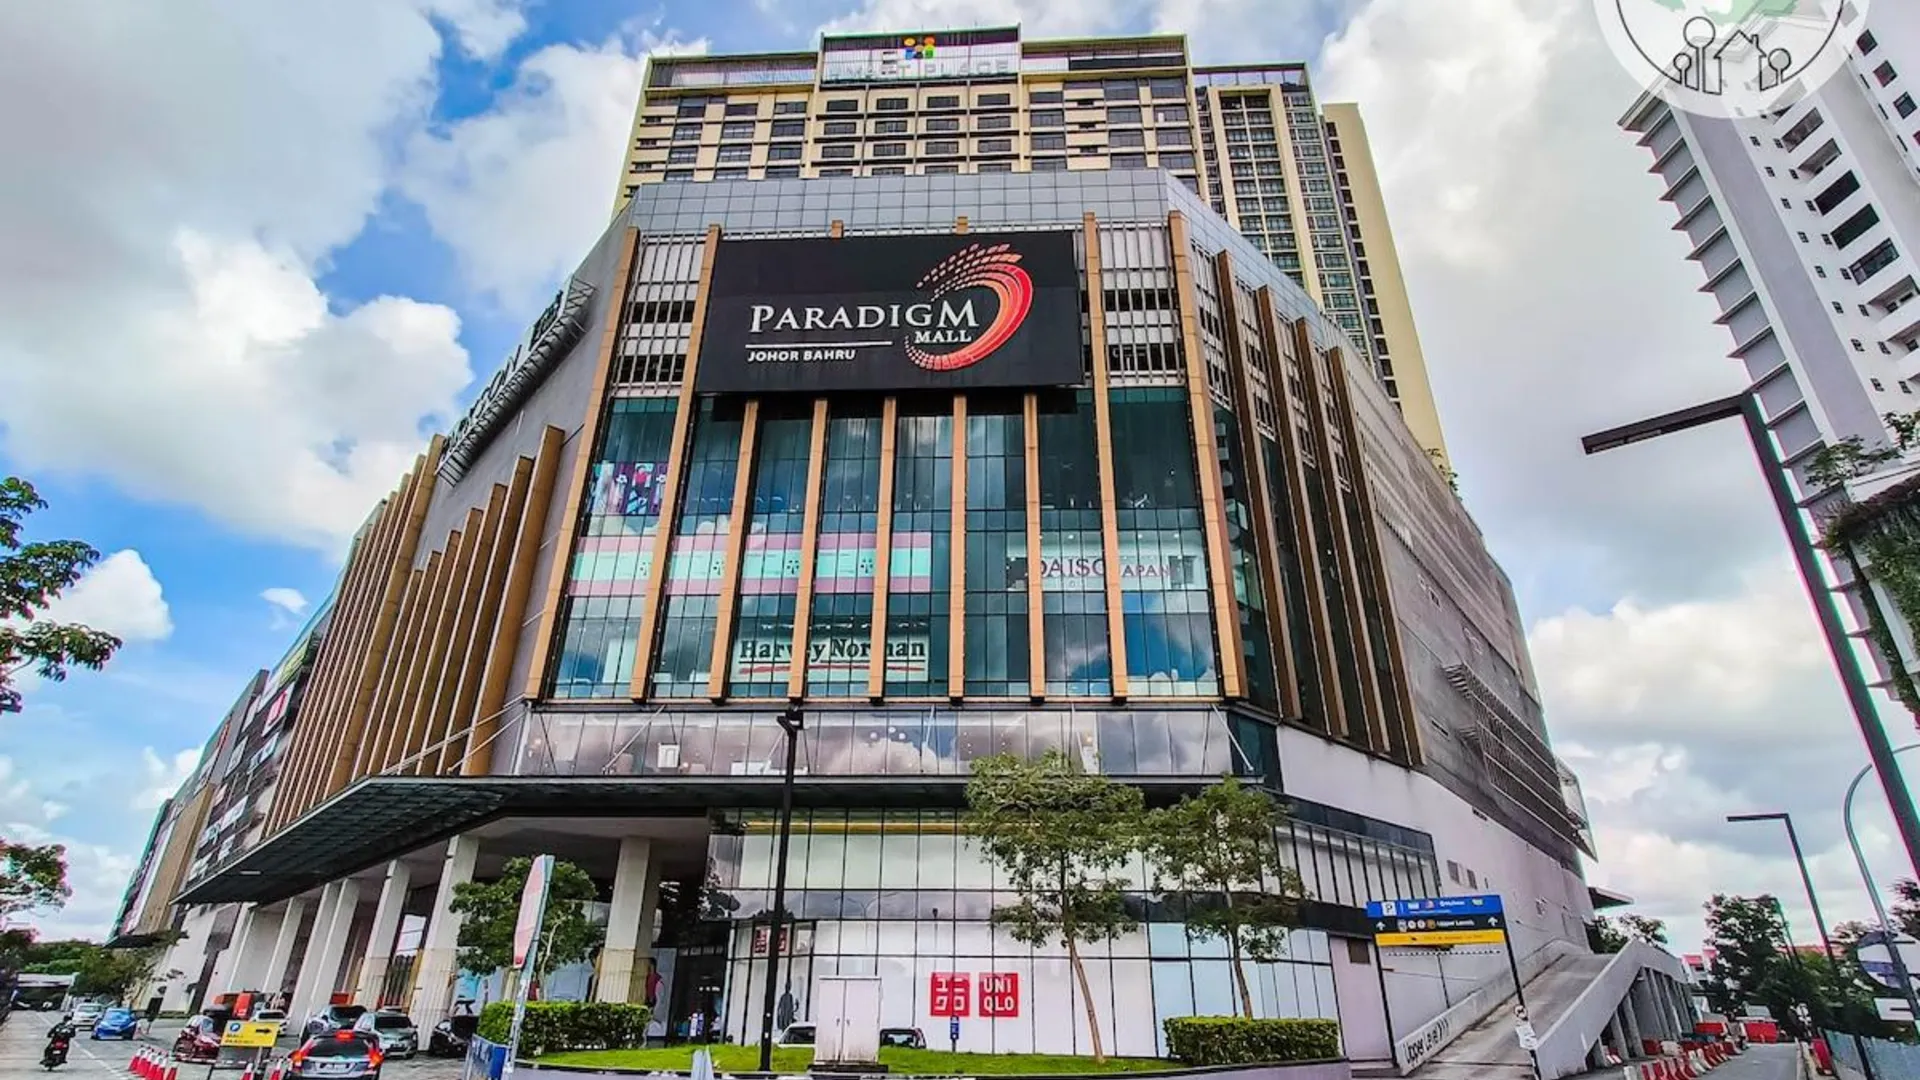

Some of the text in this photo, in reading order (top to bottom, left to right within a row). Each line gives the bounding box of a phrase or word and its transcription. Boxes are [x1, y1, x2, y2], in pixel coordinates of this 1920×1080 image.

[750, 299, 979, 332] PARADIGM
[914, 330, 972, 344] MALL
[748, 349, 856, 362] JOHOR BAHRU
[1122, 564, 1170, 577] APAN
[739, 640, 826, 661] Harvy
[983, 977, 1012, 993] UNI
[983, 996, 1014, 1013] QLO
